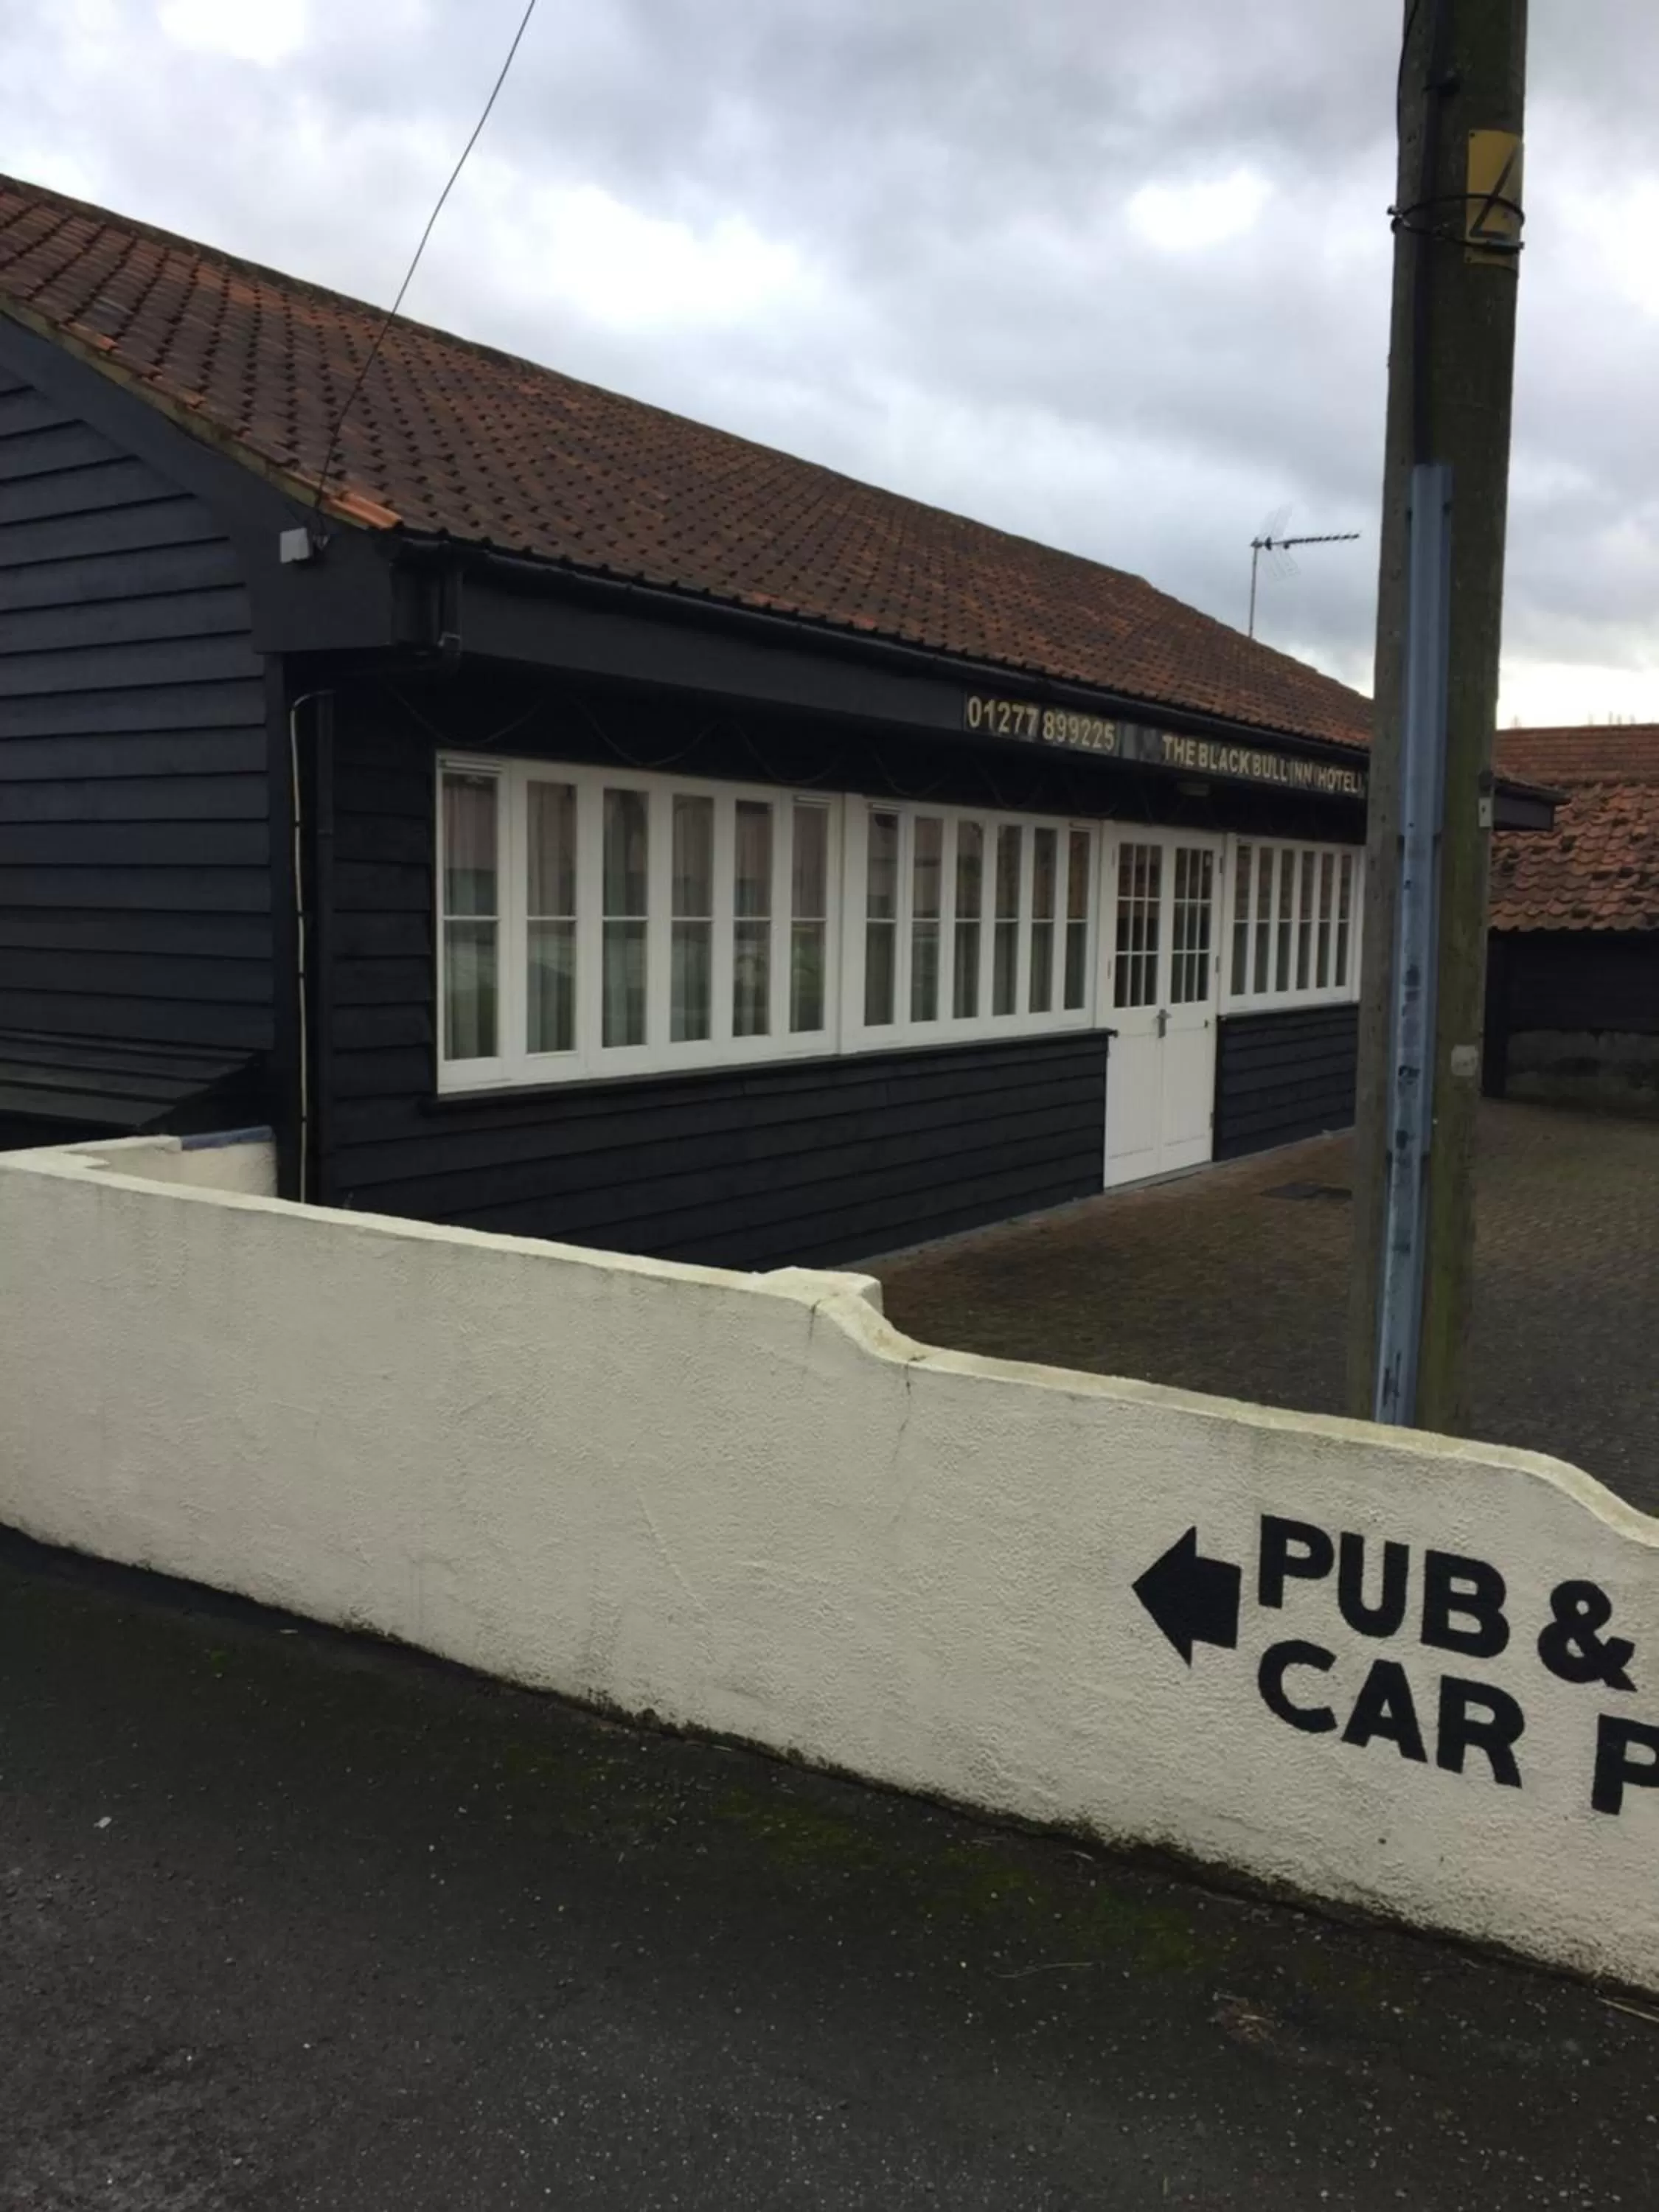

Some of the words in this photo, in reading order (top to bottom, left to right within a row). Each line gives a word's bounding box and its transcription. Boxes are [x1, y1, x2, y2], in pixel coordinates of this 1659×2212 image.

[967, 695, 1040, 737] 01277
[1042, 708, 1116, 751] 899225
[1162, 734, 1196, 767] THE
[1197, 742, 1251, 775] BLACK
[1252, 754, 1287, 783] BULL
[1289, 759, 1313, 785] INN
[1258, 1514, 1509, 1658] PUB
[1538, 1579, 1637, 1692] &
[1257, 1639, 1525, 1790] CAR
